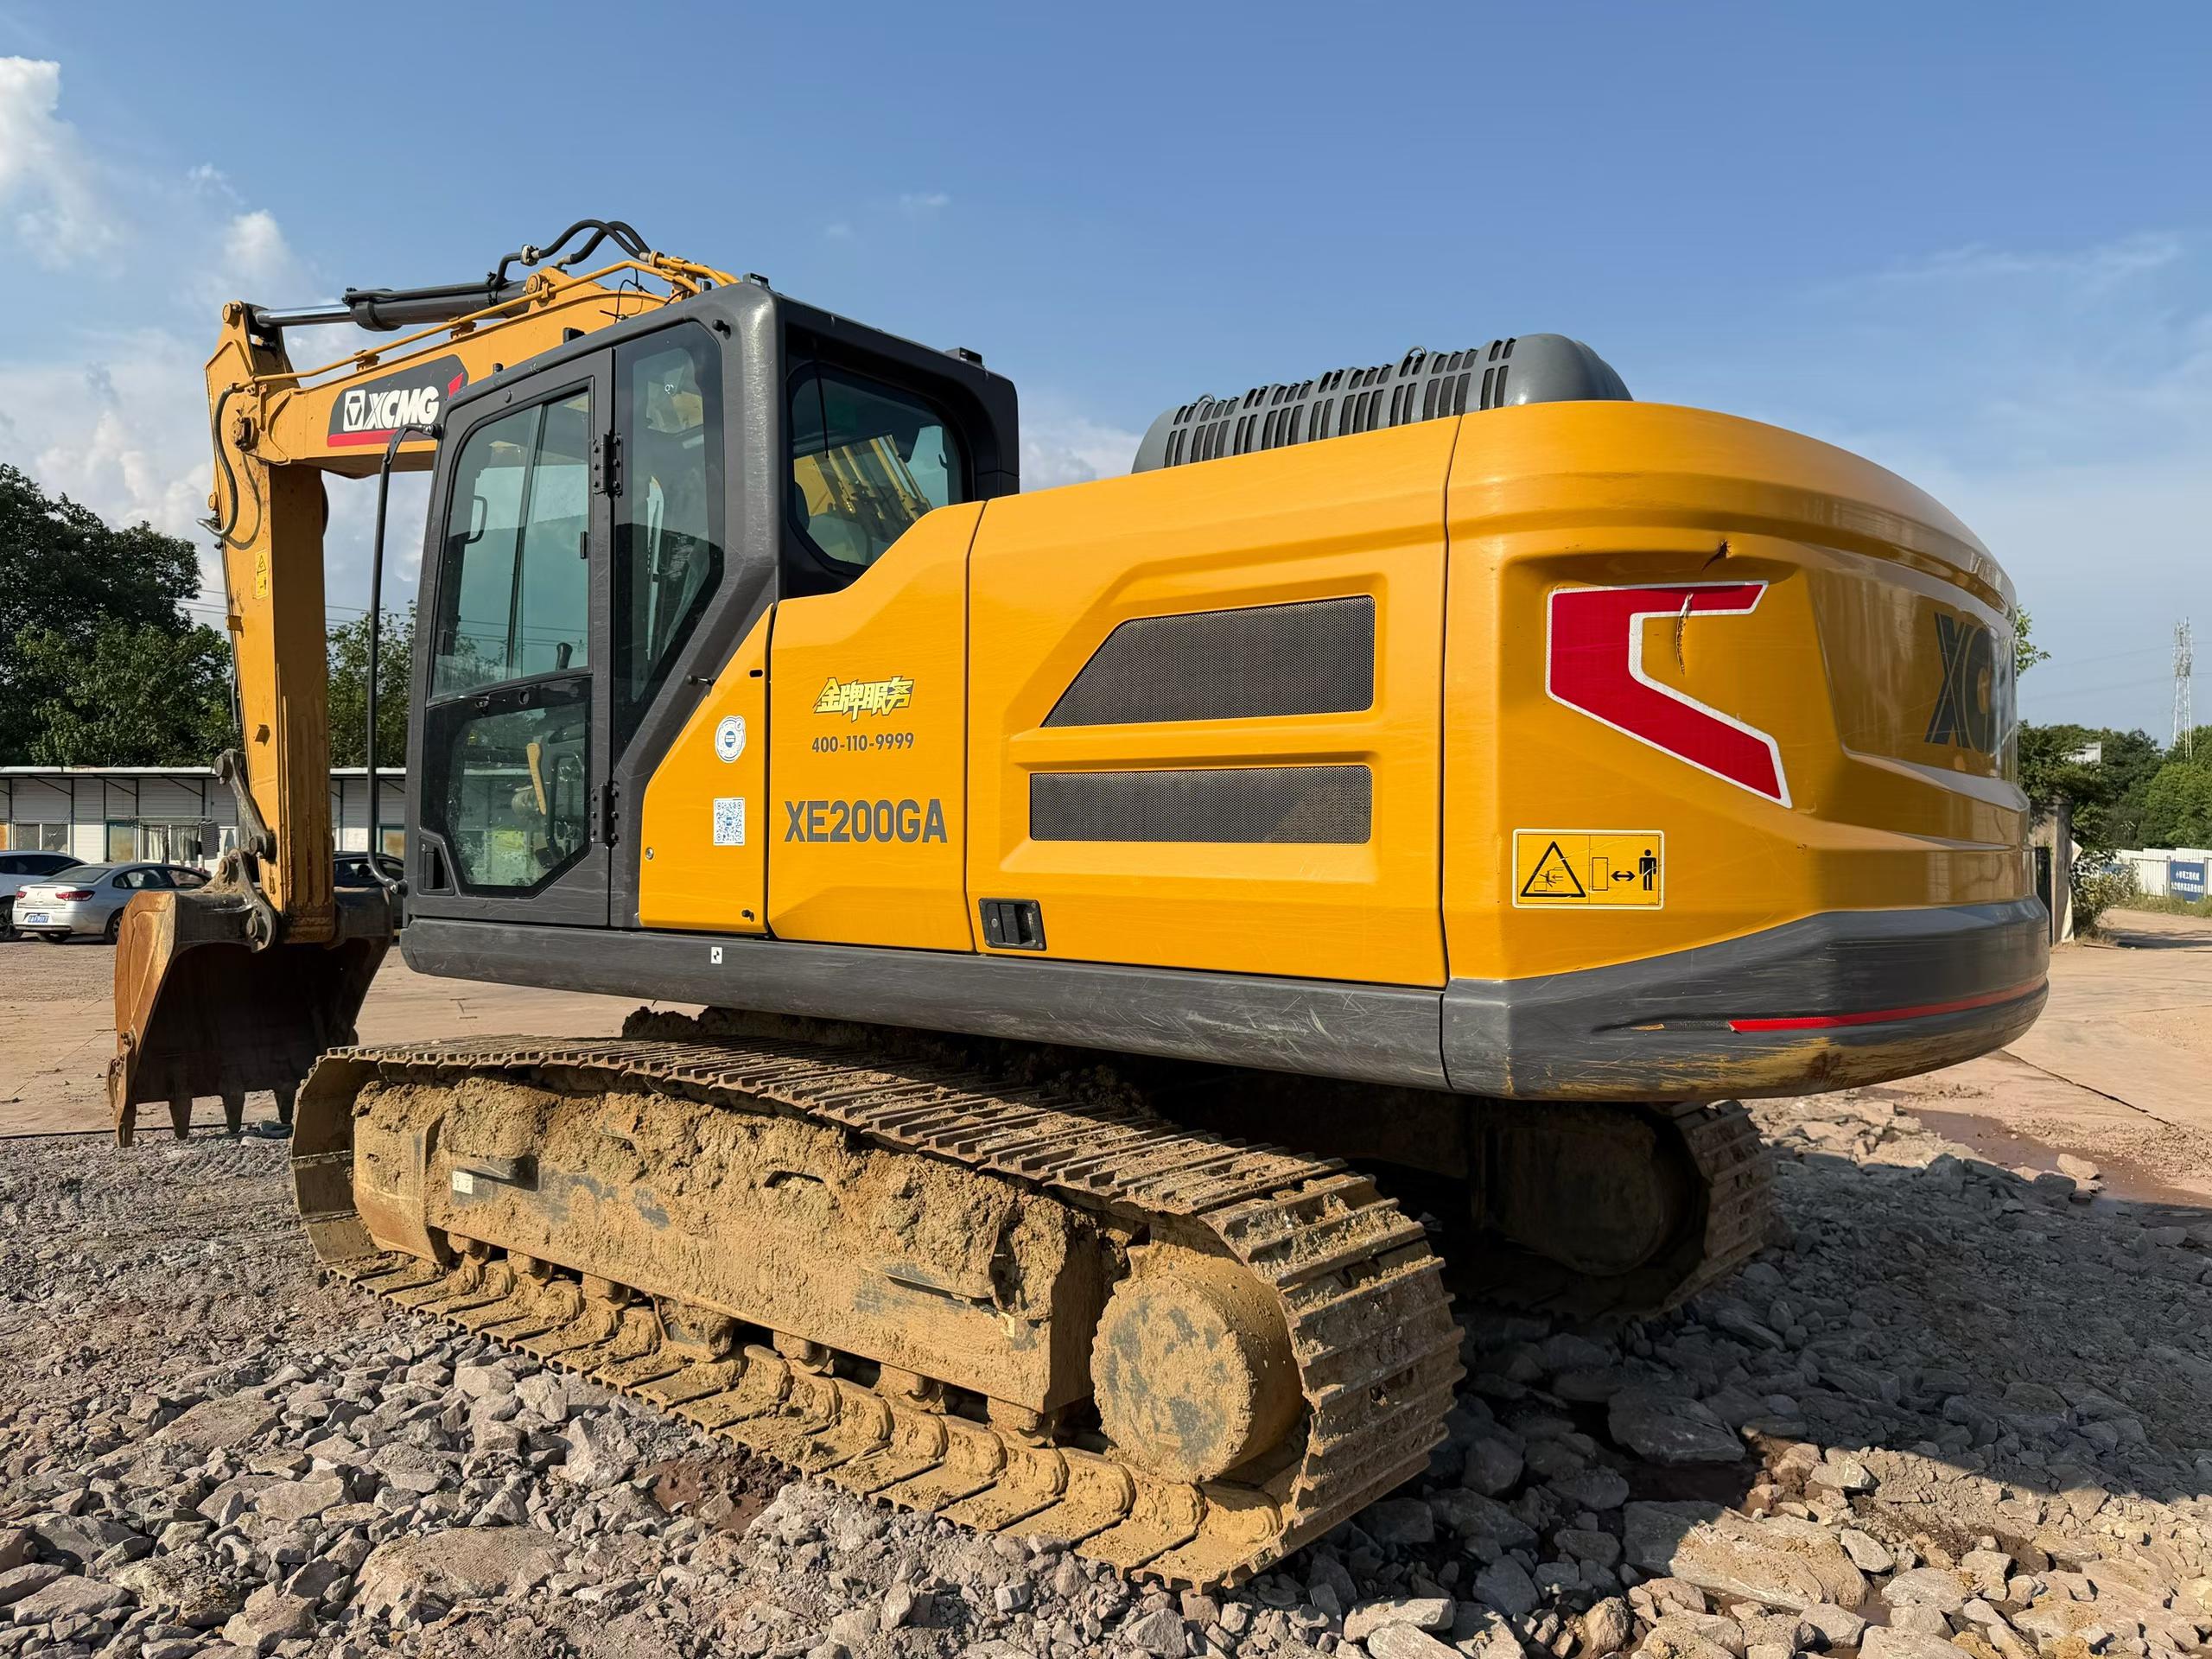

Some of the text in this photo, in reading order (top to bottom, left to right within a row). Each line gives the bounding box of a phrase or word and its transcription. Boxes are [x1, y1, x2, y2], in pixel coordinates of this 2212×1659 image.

[363, 385, 440, 429] XCMG
[812, 676, 914, 723] 金牌服务
[812, 732, 914, 753] 400-110-9999
[784, 798, 948, 843] XE200GA
